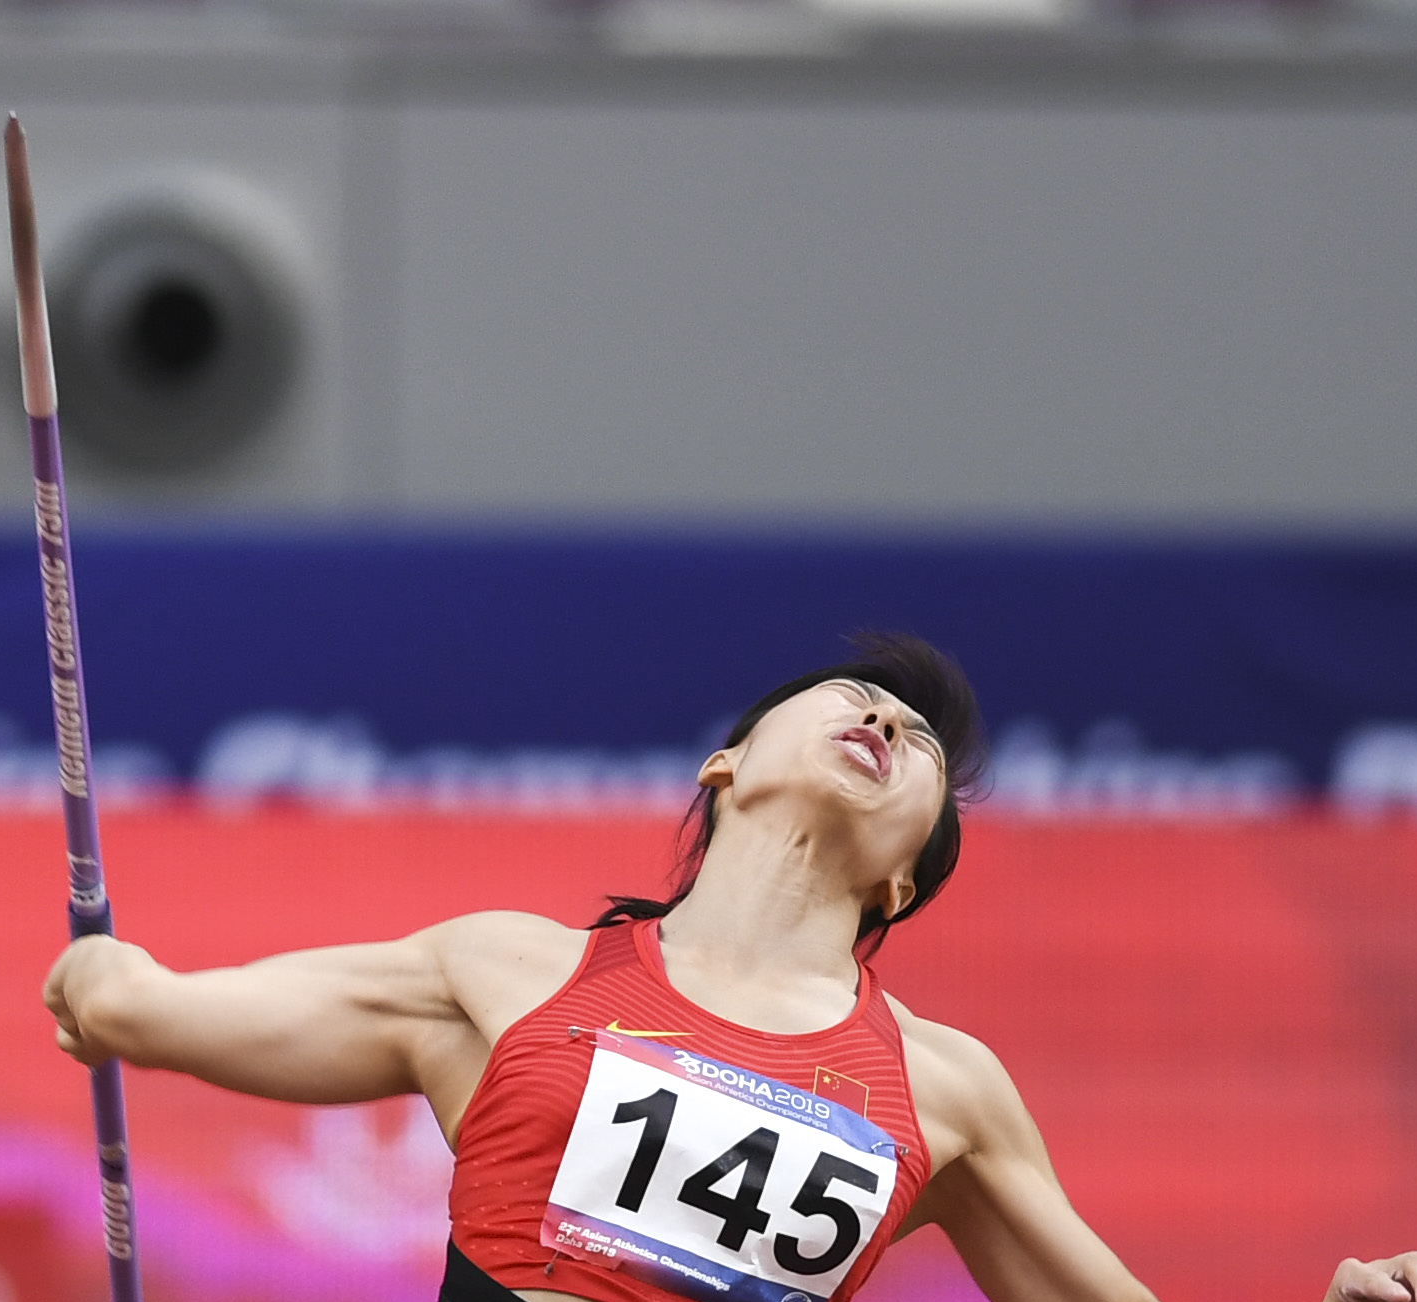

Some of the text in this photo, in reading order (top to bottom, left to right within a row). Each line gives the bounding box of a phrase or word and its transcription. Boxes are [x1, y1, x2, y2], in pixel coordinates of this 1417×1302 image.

[686, 1073, 828, 1131] Asian Athletics Championships
[611, 1087, 880, 1276] 145
[580, 1228, 611, 1244] Asian
[612, 1237, 658, 1262] Athletics
[660, 1255, 731, 1292] Championships
[584, 1241, 617, 1257] 2019
